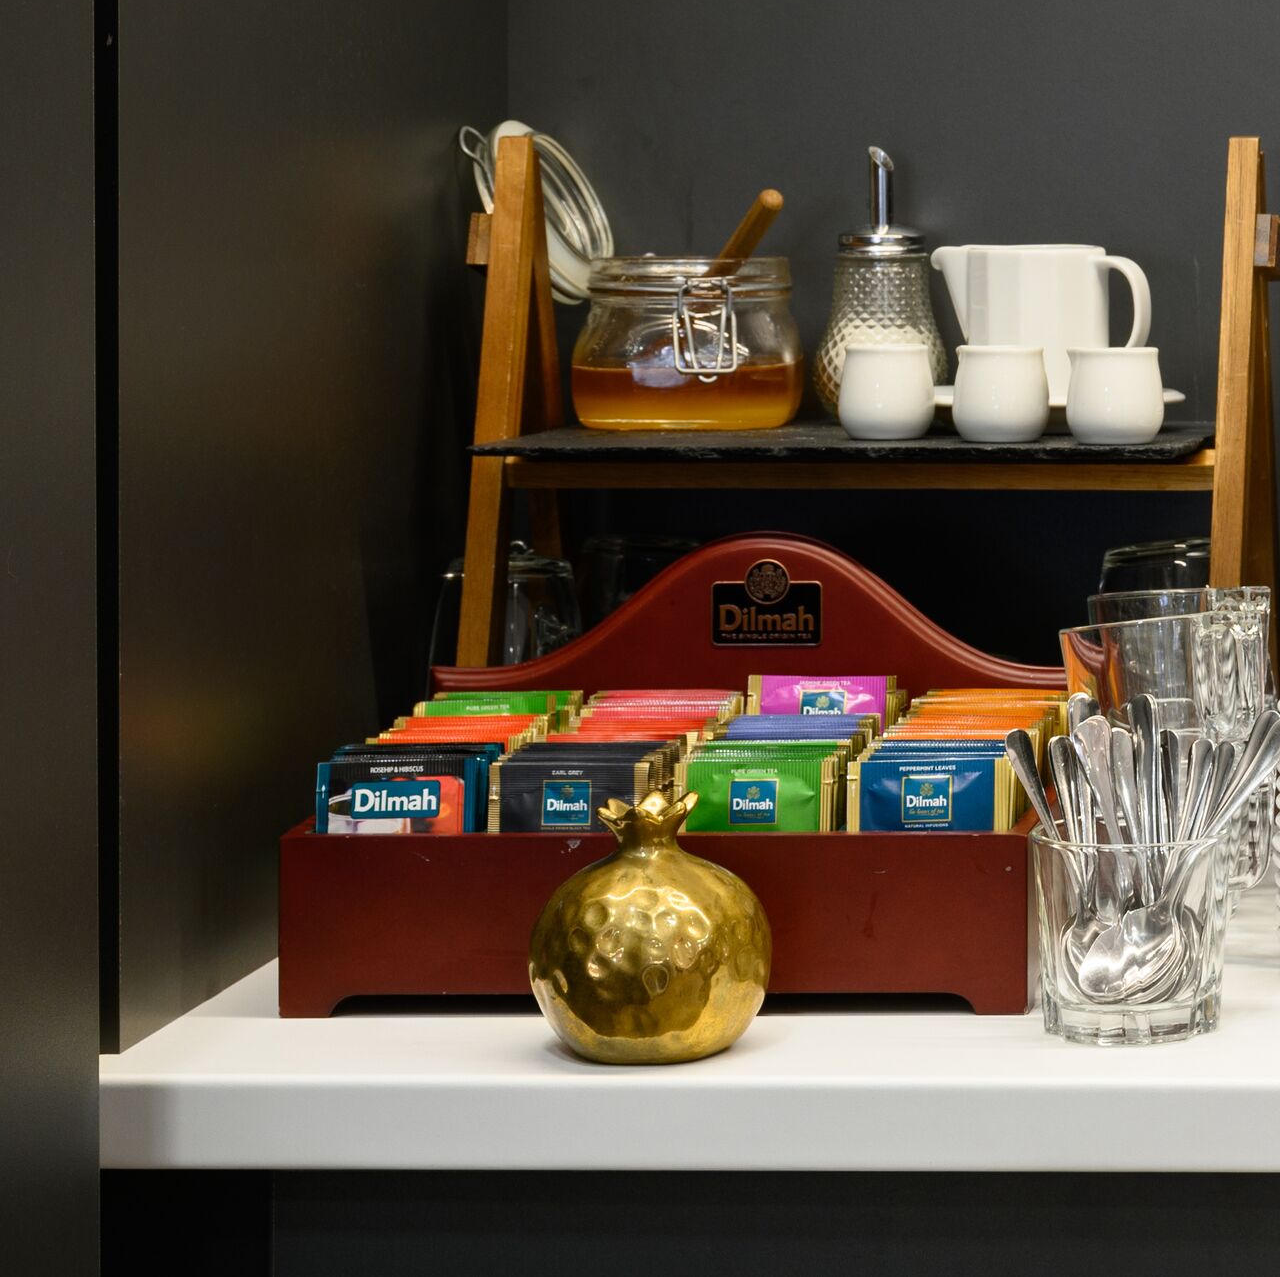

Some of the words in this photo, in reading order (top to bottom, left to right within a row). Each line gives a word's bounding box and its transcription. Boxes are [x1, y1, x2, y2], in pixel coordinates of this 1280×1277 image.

[718, 604, 815, 632] Dilmah
[370, 766, 393, 774] ROSEHIP
[399, 765, 424, 773] HIBISCUS
[353, 788, 437, 813] Dilmah
[546, 798, 588, 812] Dilmah
[732, 798, 774, 811] Dilmah
[906, 795, 947, 808] Dilmah
